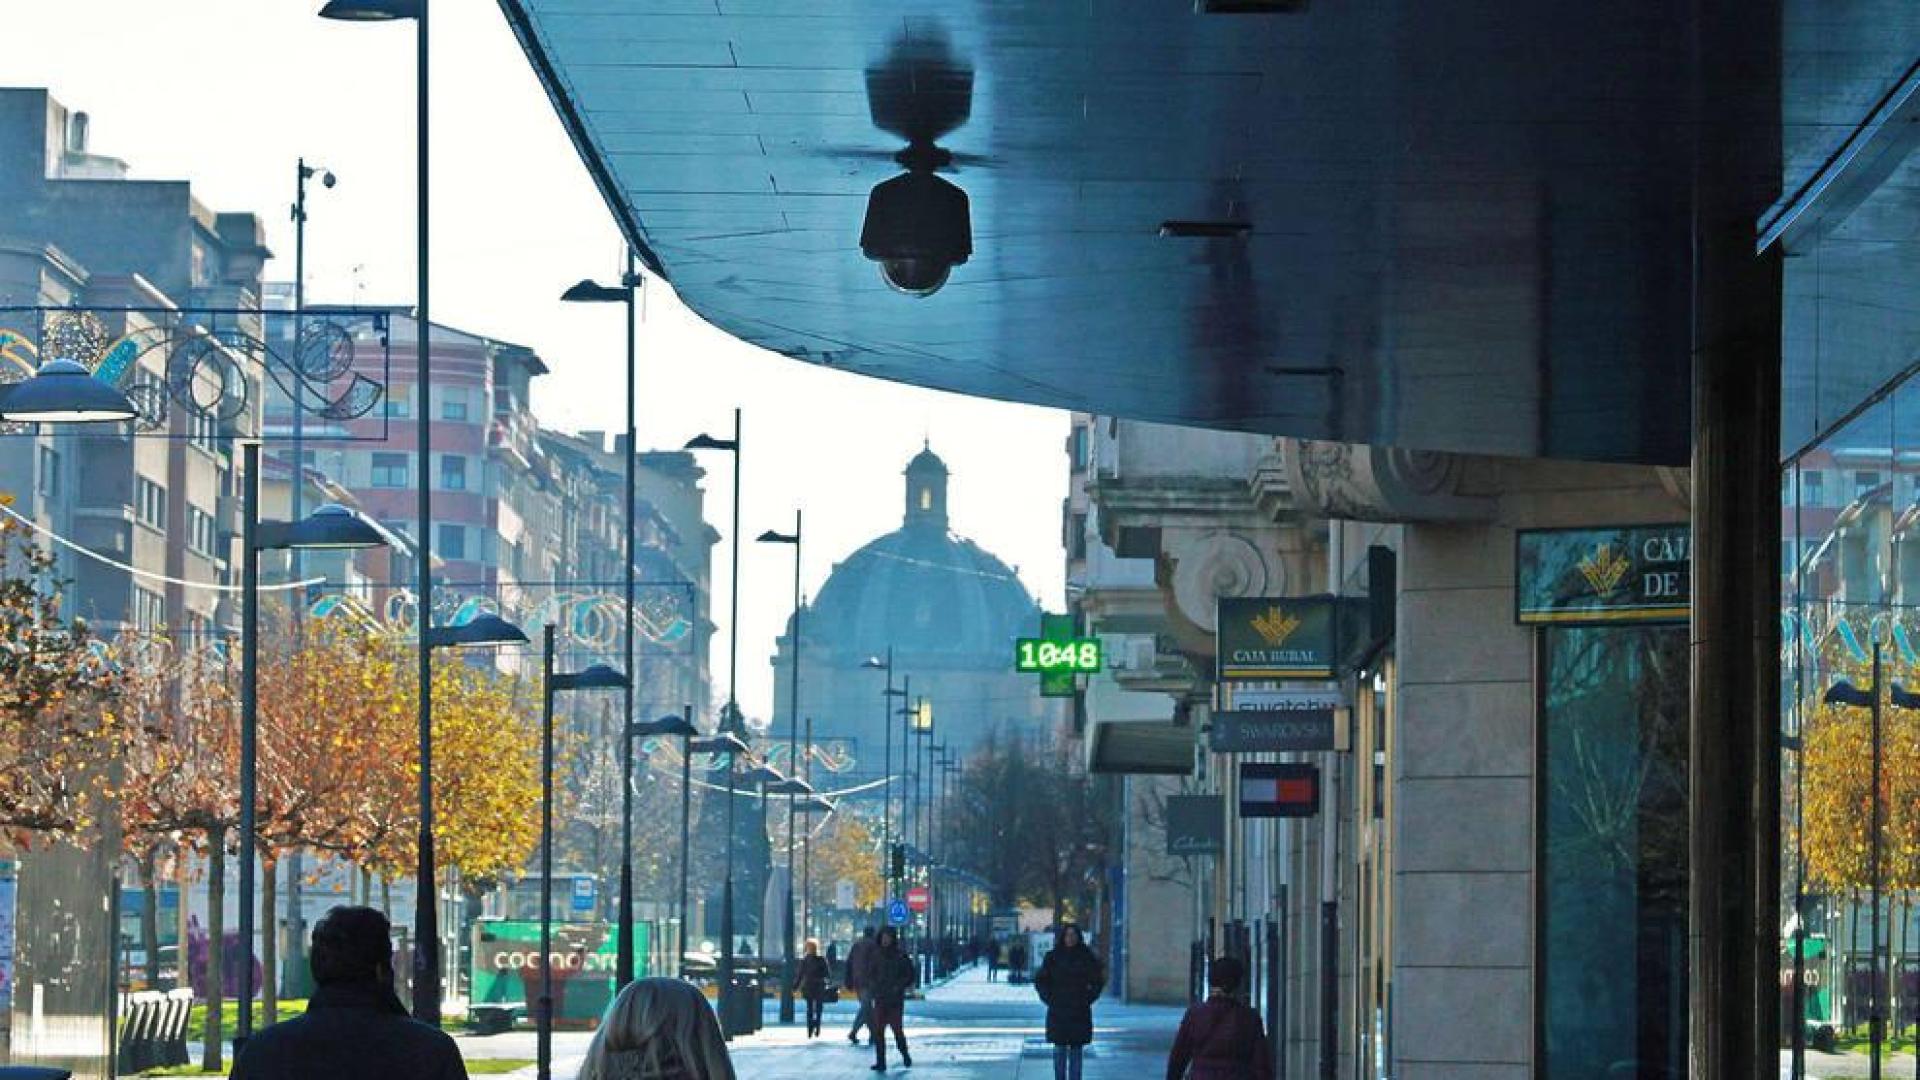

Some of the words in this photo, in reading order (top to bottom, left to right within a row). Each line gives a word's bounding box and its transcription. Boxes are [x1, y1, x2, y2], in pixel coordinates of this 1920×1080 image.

[1644, 536, 1691, 561] CAJ
[1644, 572, 1679, 596] DE
[1021, 642, 1097, 668] 10:48
[1233, 650, 1266, 662] CAJA
